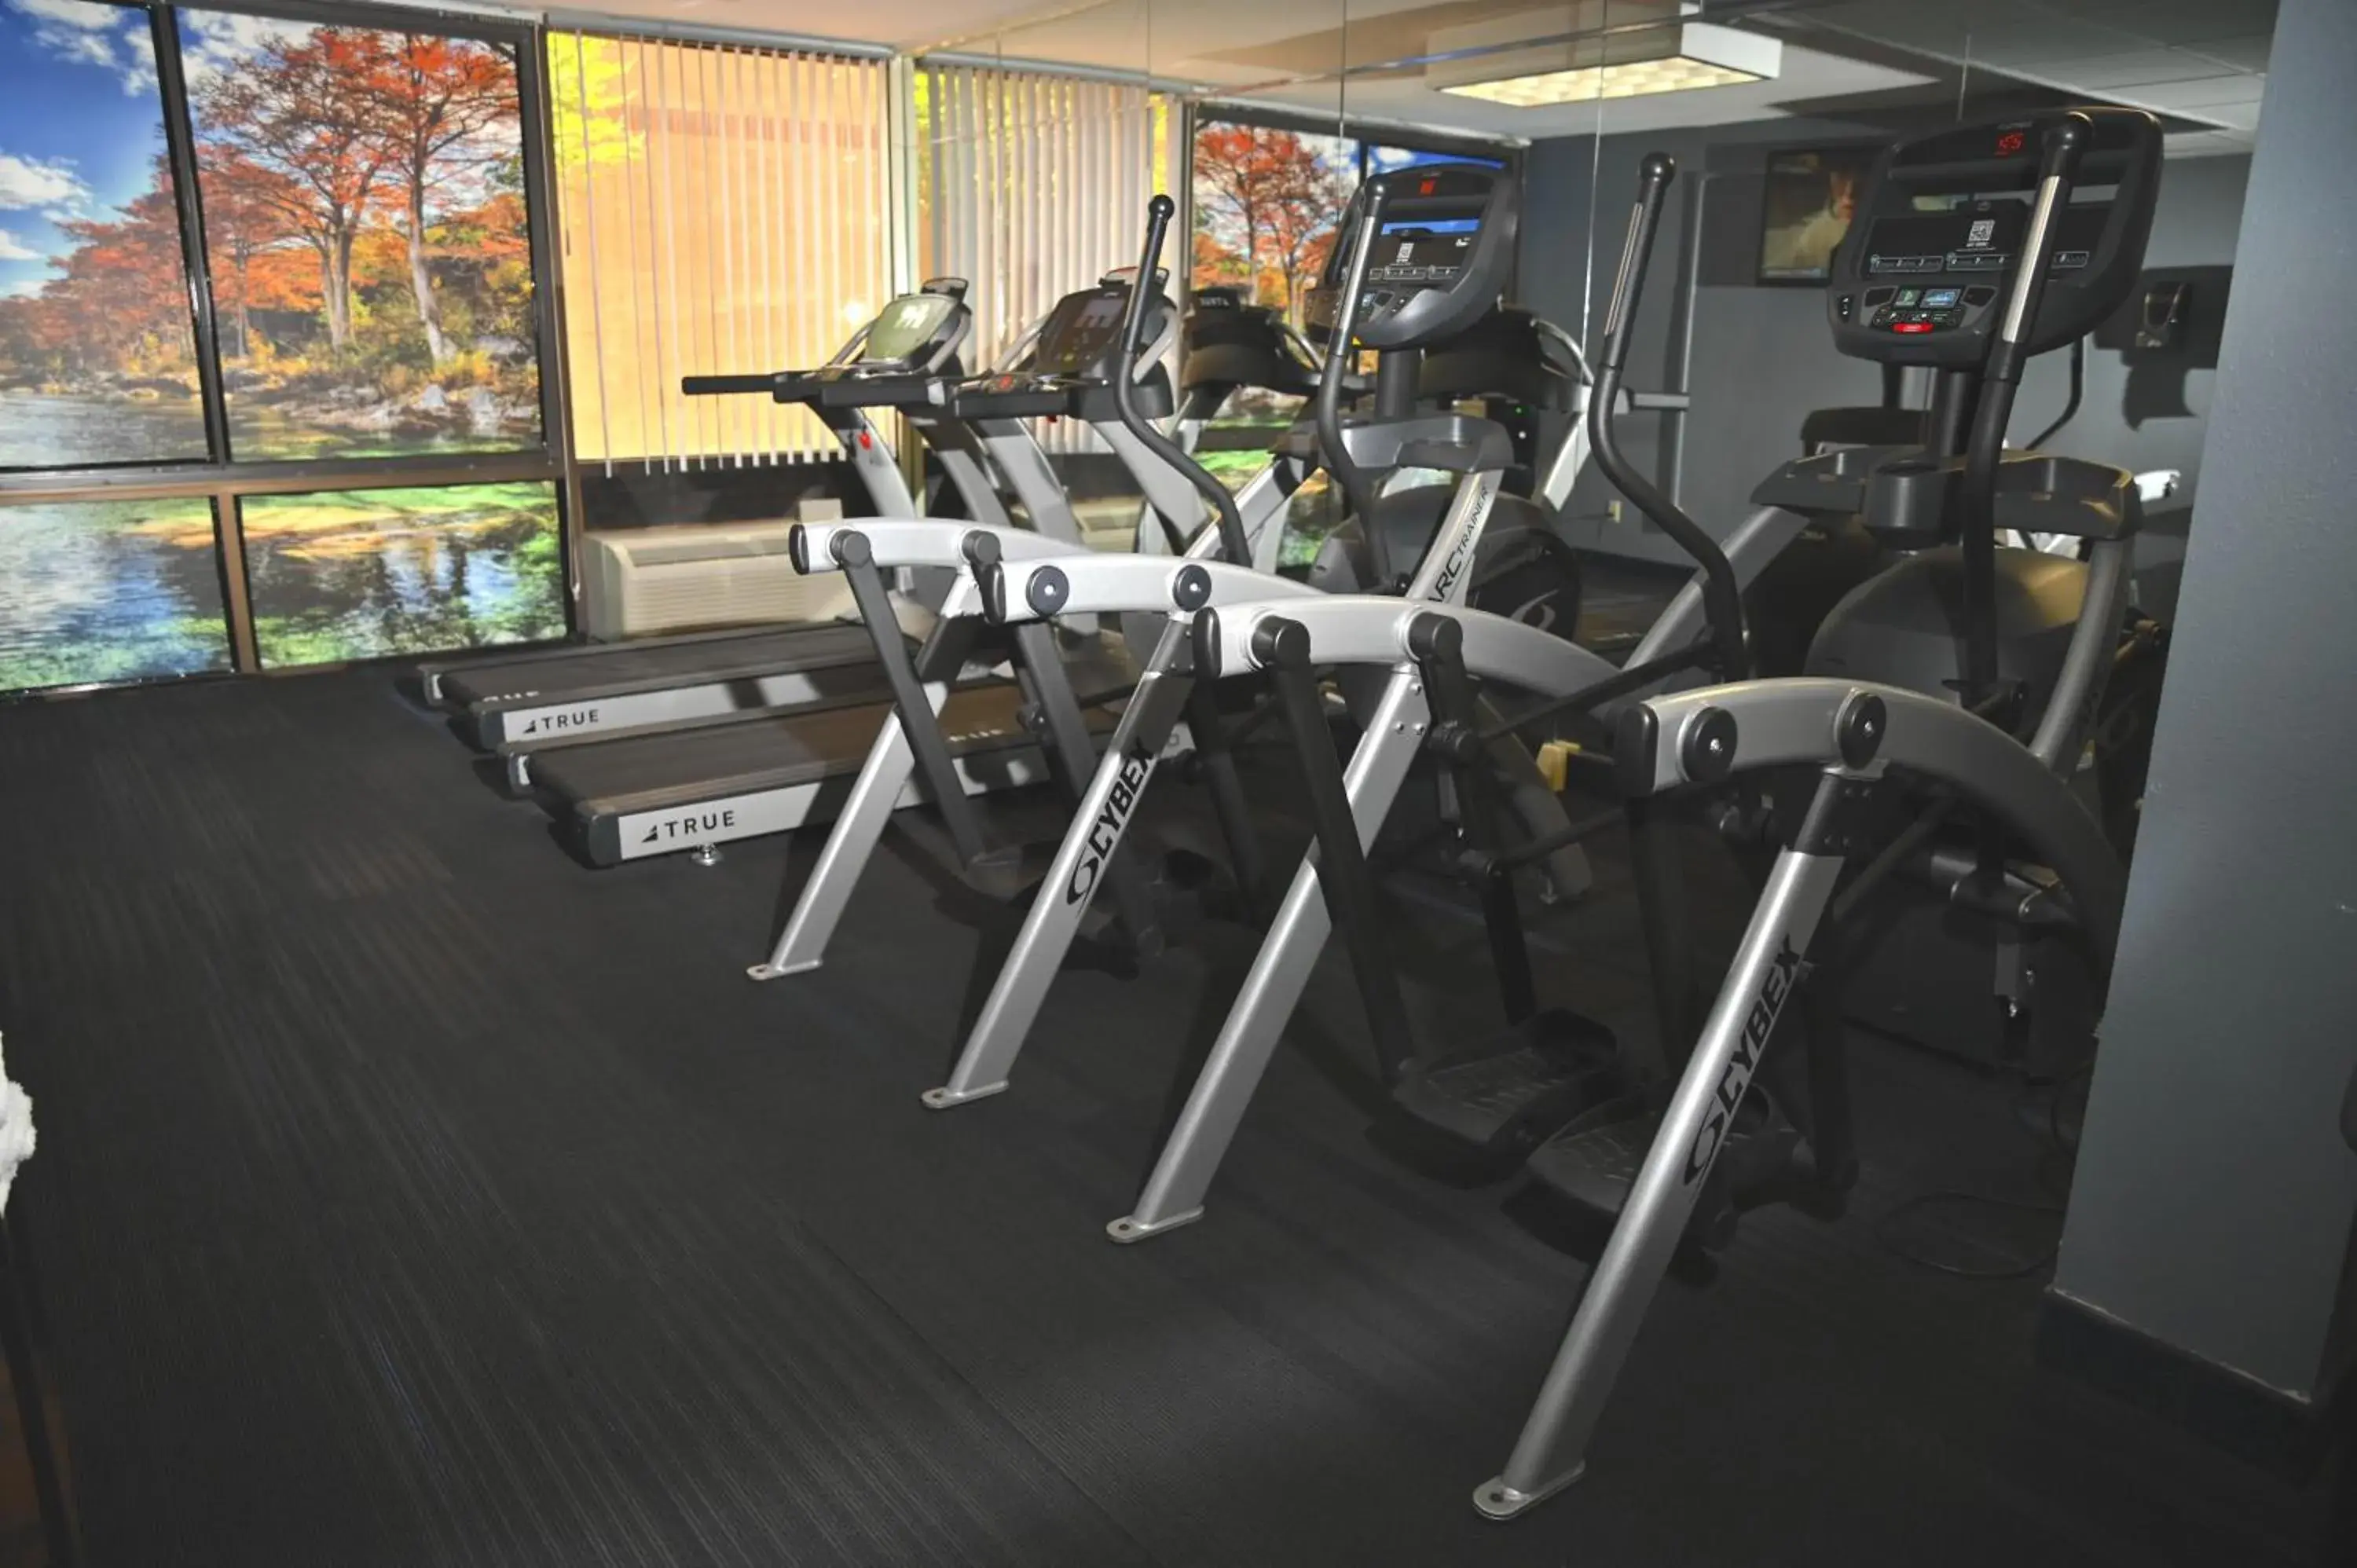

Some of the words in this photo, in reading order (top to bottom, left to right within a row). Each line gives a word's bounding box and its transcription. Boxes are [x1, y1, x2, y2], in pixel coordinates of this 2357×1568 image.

[541, 709, 599, 730] TRUE
[664, 810, 735, 837] TRUE
[1088, 736, 1156, 860] CYBEX
[1717, 932, 1801, 1115] CYBEX
